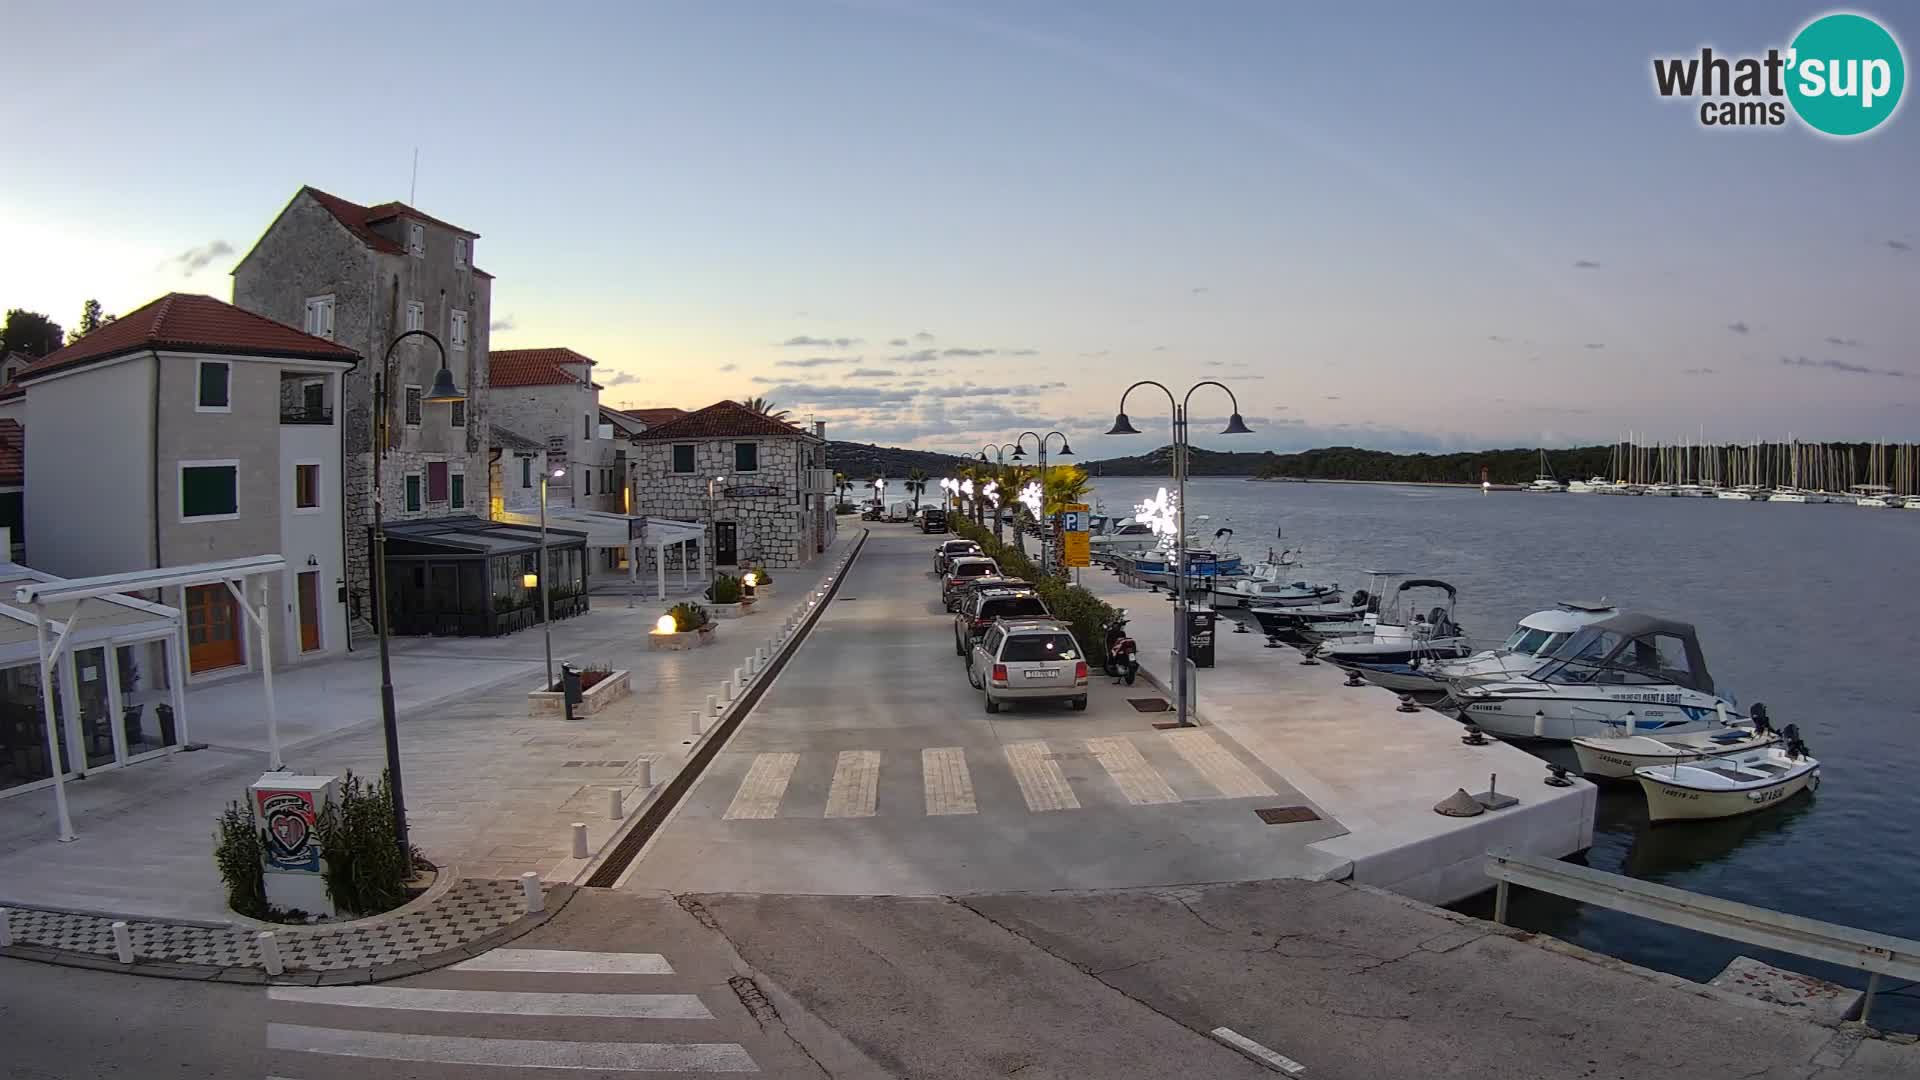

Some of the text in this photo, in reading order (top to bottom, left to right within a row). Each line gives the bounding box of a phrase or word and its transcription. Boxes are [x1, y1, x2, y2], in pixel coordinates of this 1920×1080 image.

[1066, 513, 1077, 530] P
[1642, 693, 1660, 702] RENT
[1660, 693, 1665, 702] A
[1666, 693, 1682, 704] BOAT
